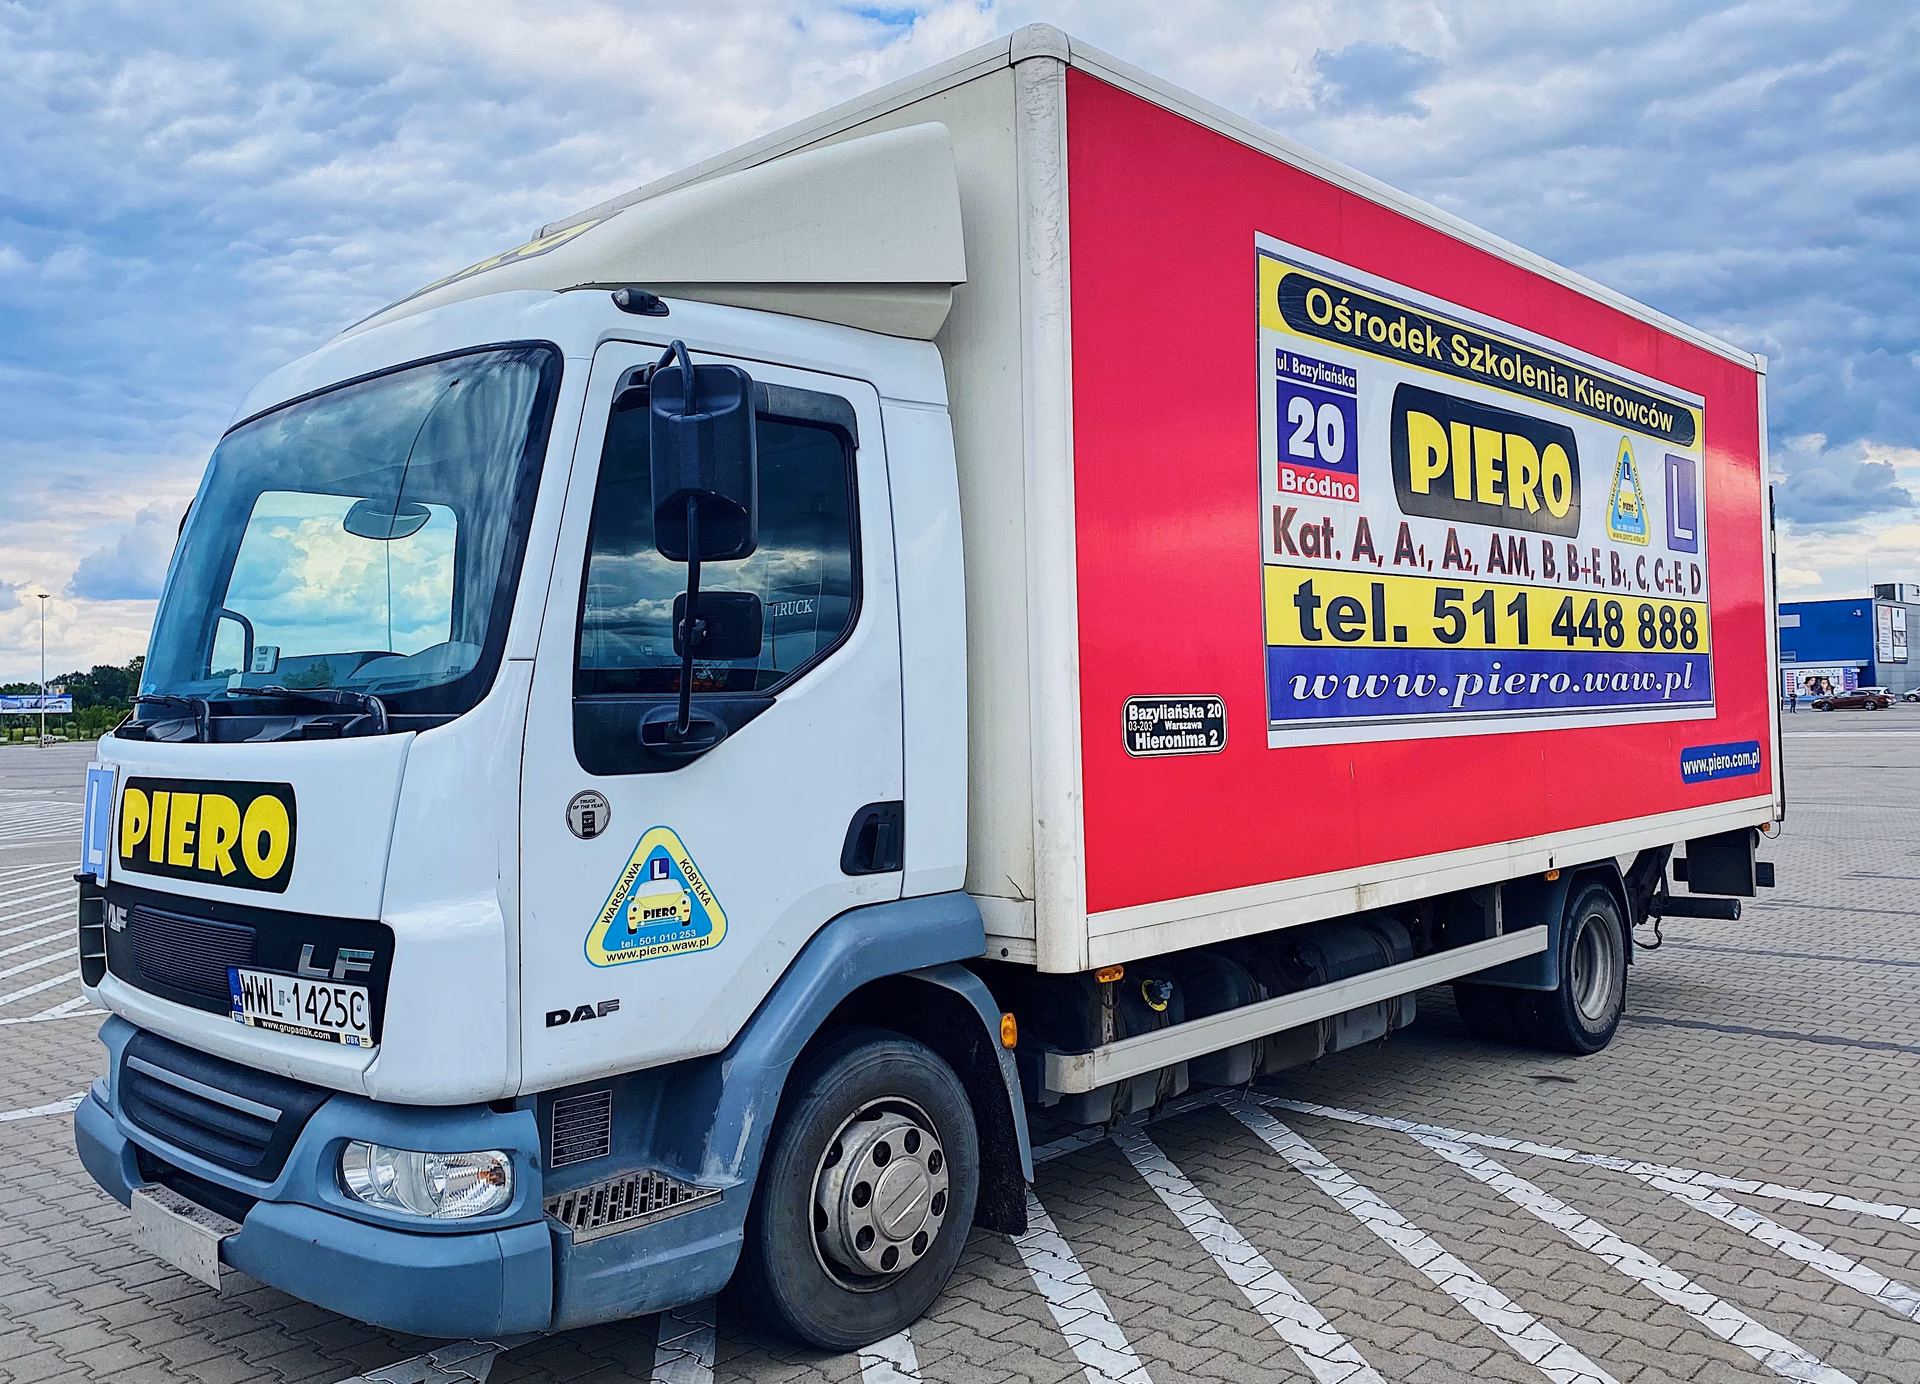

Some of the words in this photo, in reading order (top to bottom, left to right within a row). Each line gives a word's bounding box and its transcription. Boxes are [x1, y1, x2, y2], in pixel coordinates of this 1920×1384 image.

[1277, 353, 1290, 372] ul.
[1292, 356, 1356, 388] Bazyliańska
[1305, 286, 1443, 360] Ośrodek
[1451, 334, 1569, 398] Szkolenia
[1574, 374, 1674, 433] Kierowców
[1287, 396, 1345, 464] 20
[1407, 410, 1573, 519] PIERO
[1281, 468, 1356, 500] Bródno
[1672, 463, 1693, 541] L
[1272, 505, 1342, 560] Kat.
[1351, 516, 1384, 568] A,
[1486, 533, 1536, 581] AM,
[1542, 539, 1561, 584] B,
[1566, 543, 1605, 588] B+E,
[1635, 554, 1650, 593] C,
[1654, 557, 1686, 597] C+E,
[1690, 562, 1702, 595] D
[773, 599, 814, 617] TRUCK
[1293, 579, 1408, 643] tel.
[1432, 587, 1530, 646] 511
[1551, 595, 1626, 649] 448
[1638, 603, 1699, 651] 888
[1288, 661, 1694, 709] www.piero.waw.pl
[1128, 703, 1205, 723] Bazyliańska
[1207, 703, 1222, 718] 20
[1128, 720, 1153, 731] 03-203
[1164, 720, 1203, 731] Warszawa
[1135, 731, 1207, 750] Hieronima
[1209, 729, 1219, 746] 2
[1682, 746, 1760, 776] www.piero.com.pl
[88, 779, 103, 866] L
[121, 787, 290, 880] PIERO
[653, 860, 667, 880] L
[679, 858, 712, 907] KOBYŁKA
[601, 862, 642, 925] WARSZAWA
[102, 898, 128, 932] AF
[643, 906, 677, 919] PIERO
[606, 936, 709, 962] www.piero.waw.pl
[621, 938, 637, 949] tel.
[639, 935, 657, 946] 501
[659, 932, 677, 943] 010
[679, 929, 697, 939] 253
[297, 943, 375, 980] LF
[233, 994, 242, 1006] PL
[240, 973, 283, 1018] WWL
[292, 982, 367, 1032] 1425C
[546, 999, 620, 1028] DAF
[261, 1019, 331, 1041] www.grupadbk.com
[345, 1035, 360, 1045] DBK
